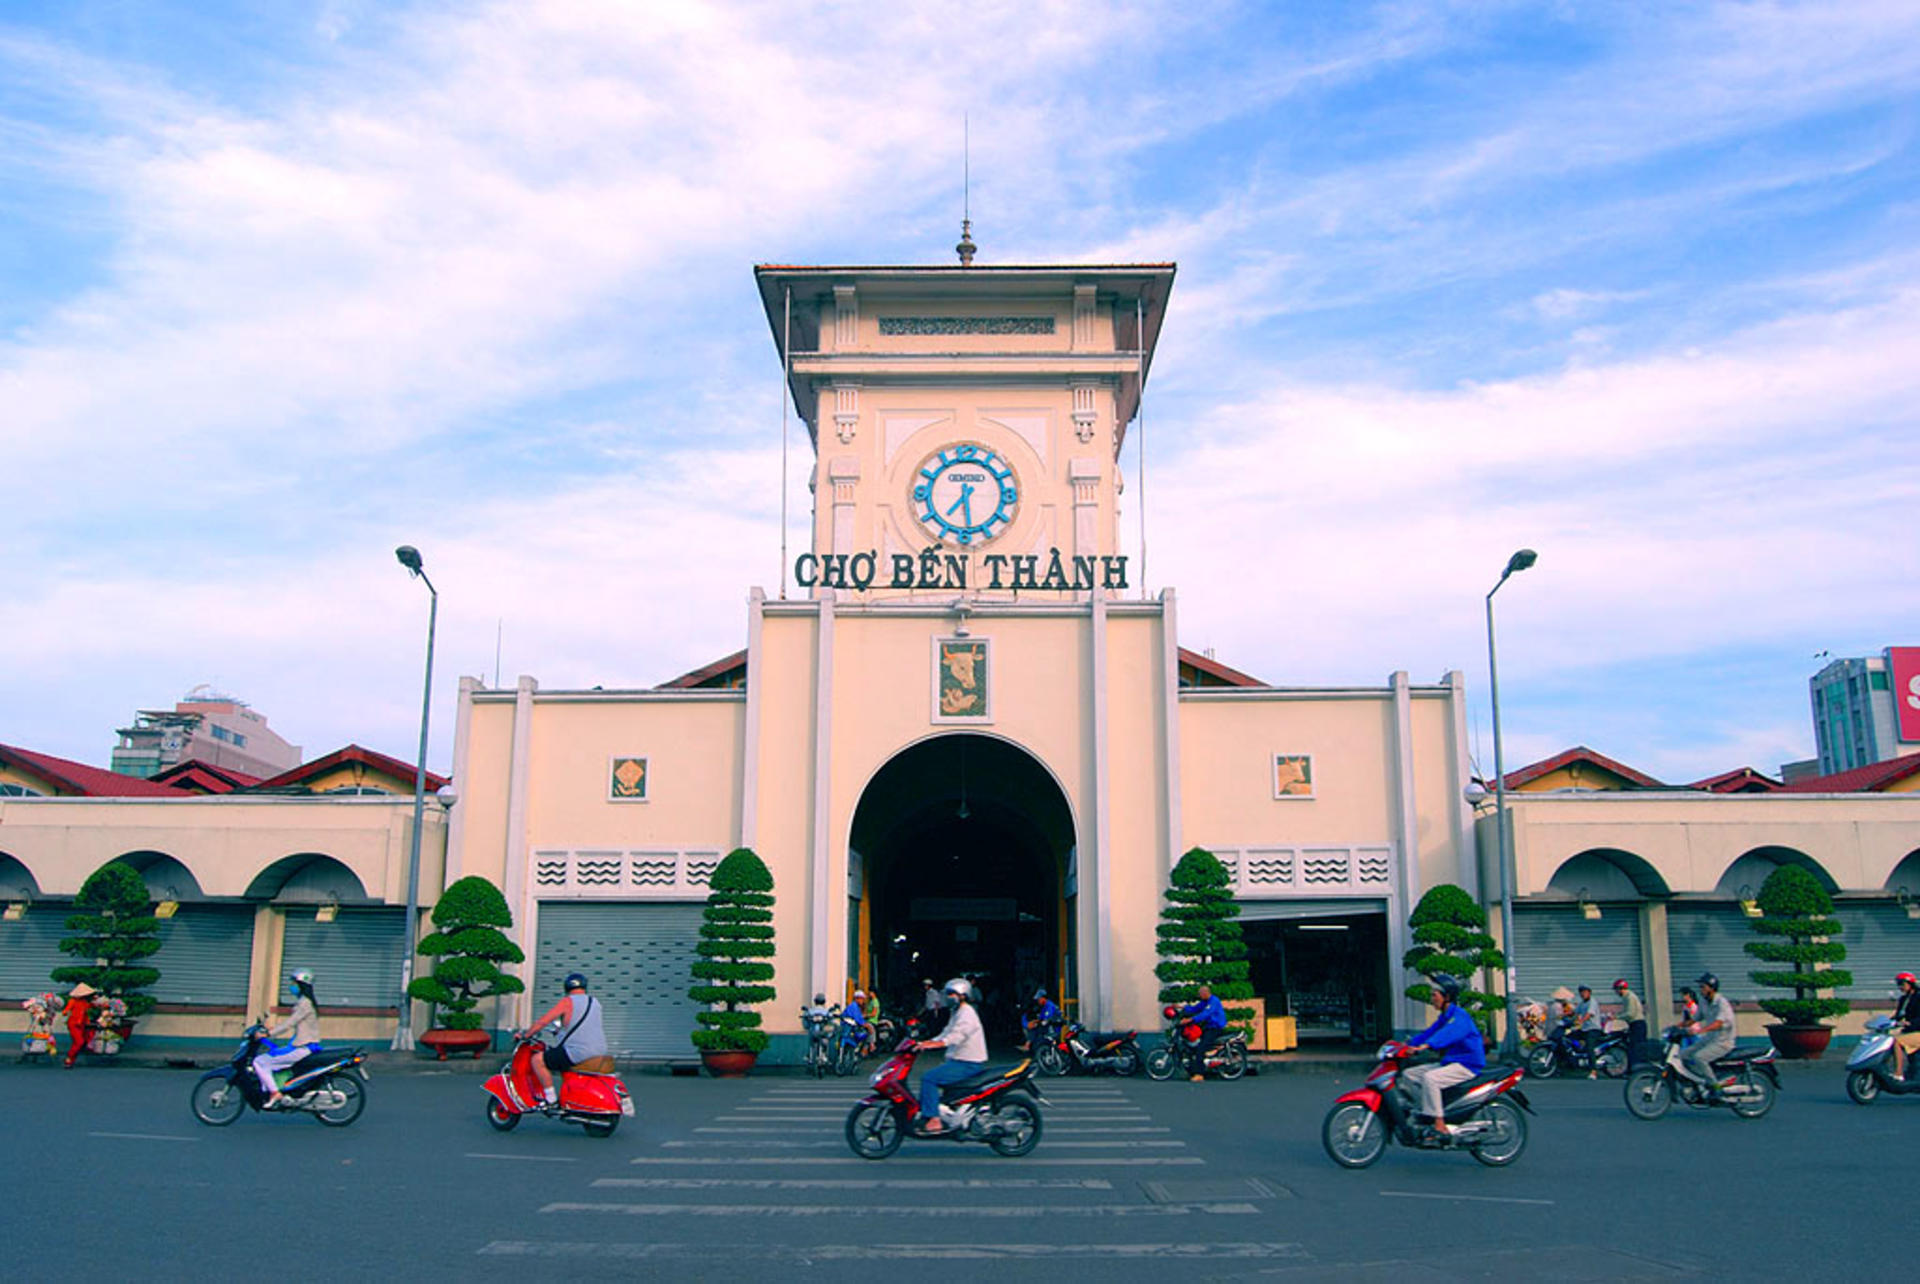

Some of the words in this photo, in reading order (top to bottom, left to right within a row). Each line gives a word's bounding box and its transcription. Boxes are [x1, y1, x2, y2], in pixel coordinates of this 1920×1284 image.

[955, 445, 979, 461] 12
[794, 549, 878, 592] CHỢ
[891, 542, 969, 589] BẾN
[983, 546, 1129, 590] THÀNH
